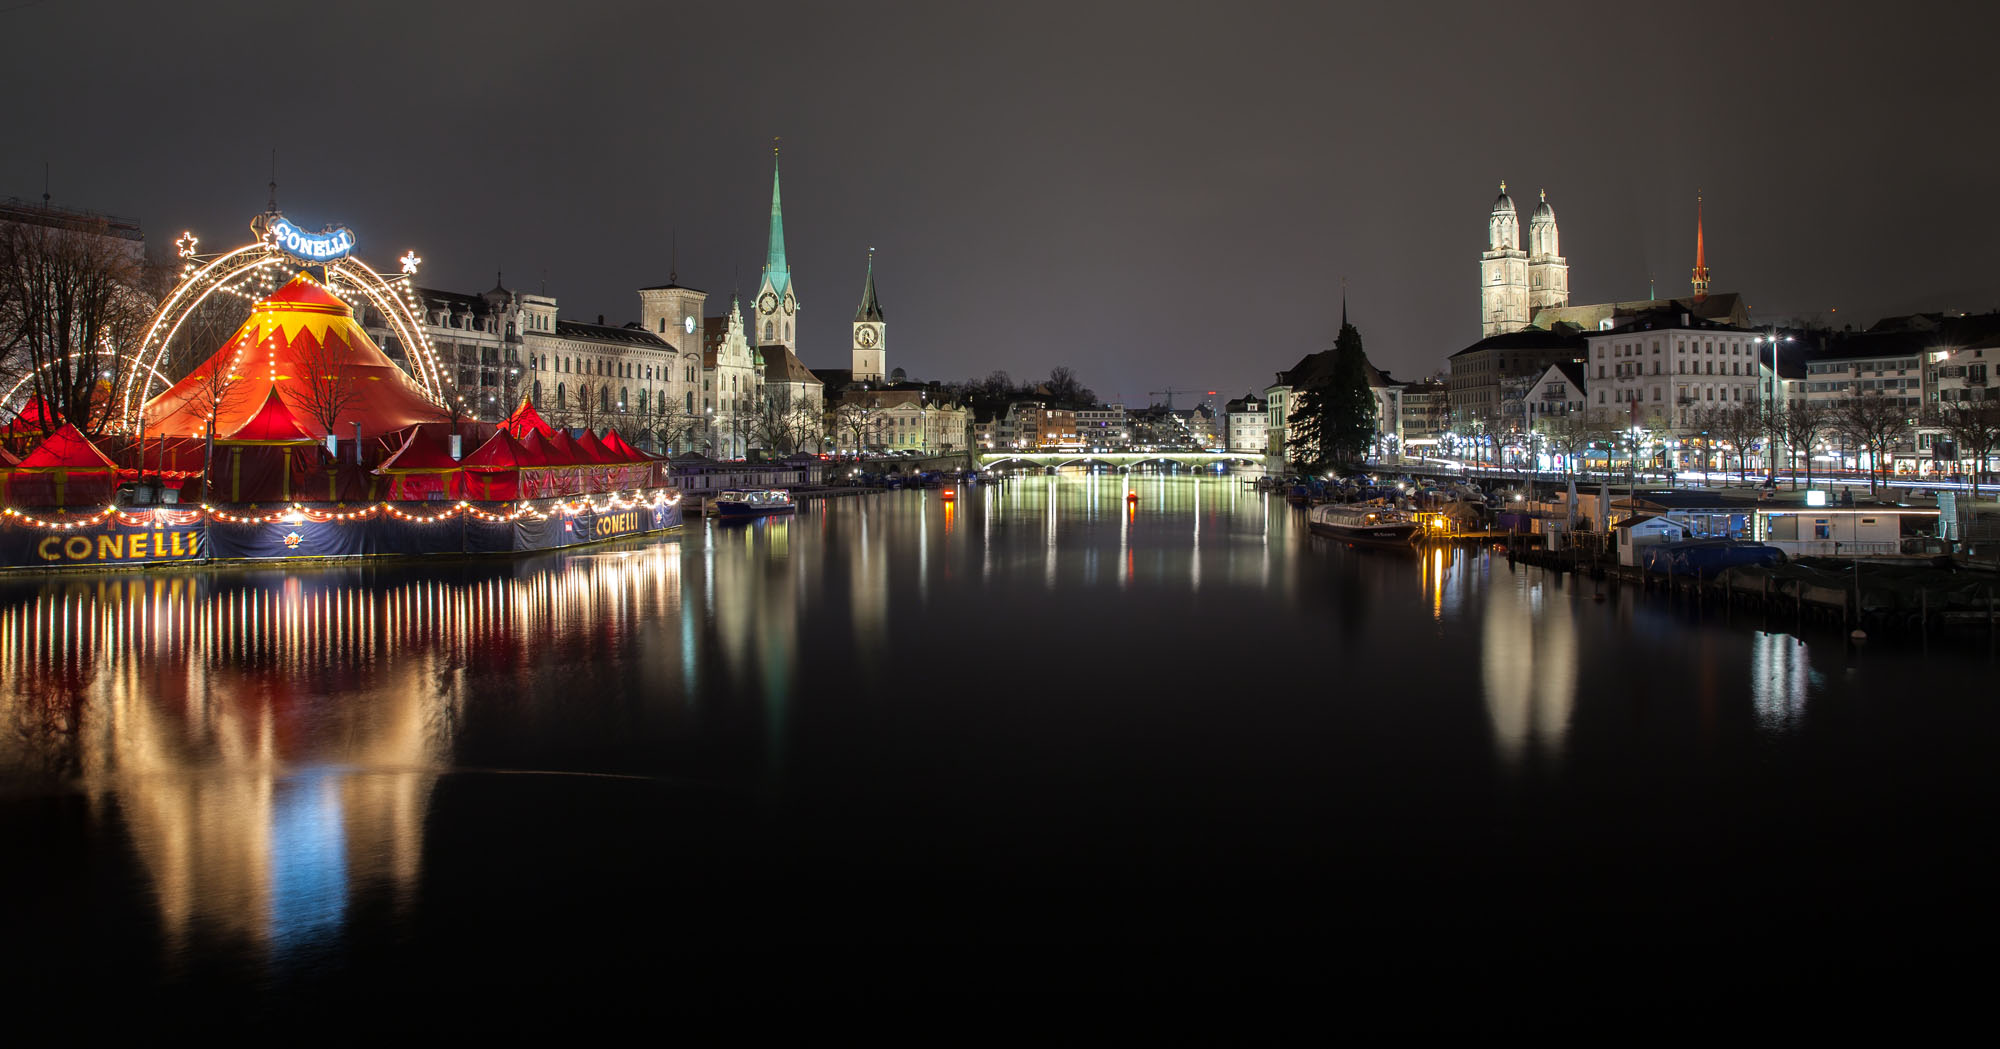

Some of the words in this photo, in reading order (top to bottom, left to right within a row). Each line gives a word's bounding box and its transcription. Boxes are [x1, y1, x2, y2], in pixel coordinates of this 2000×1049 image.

[271, 223, 351, 257] CONELLI
[596, 511, 638, 536] CONELLI
[38, 531, 198, 560] CONELLI
